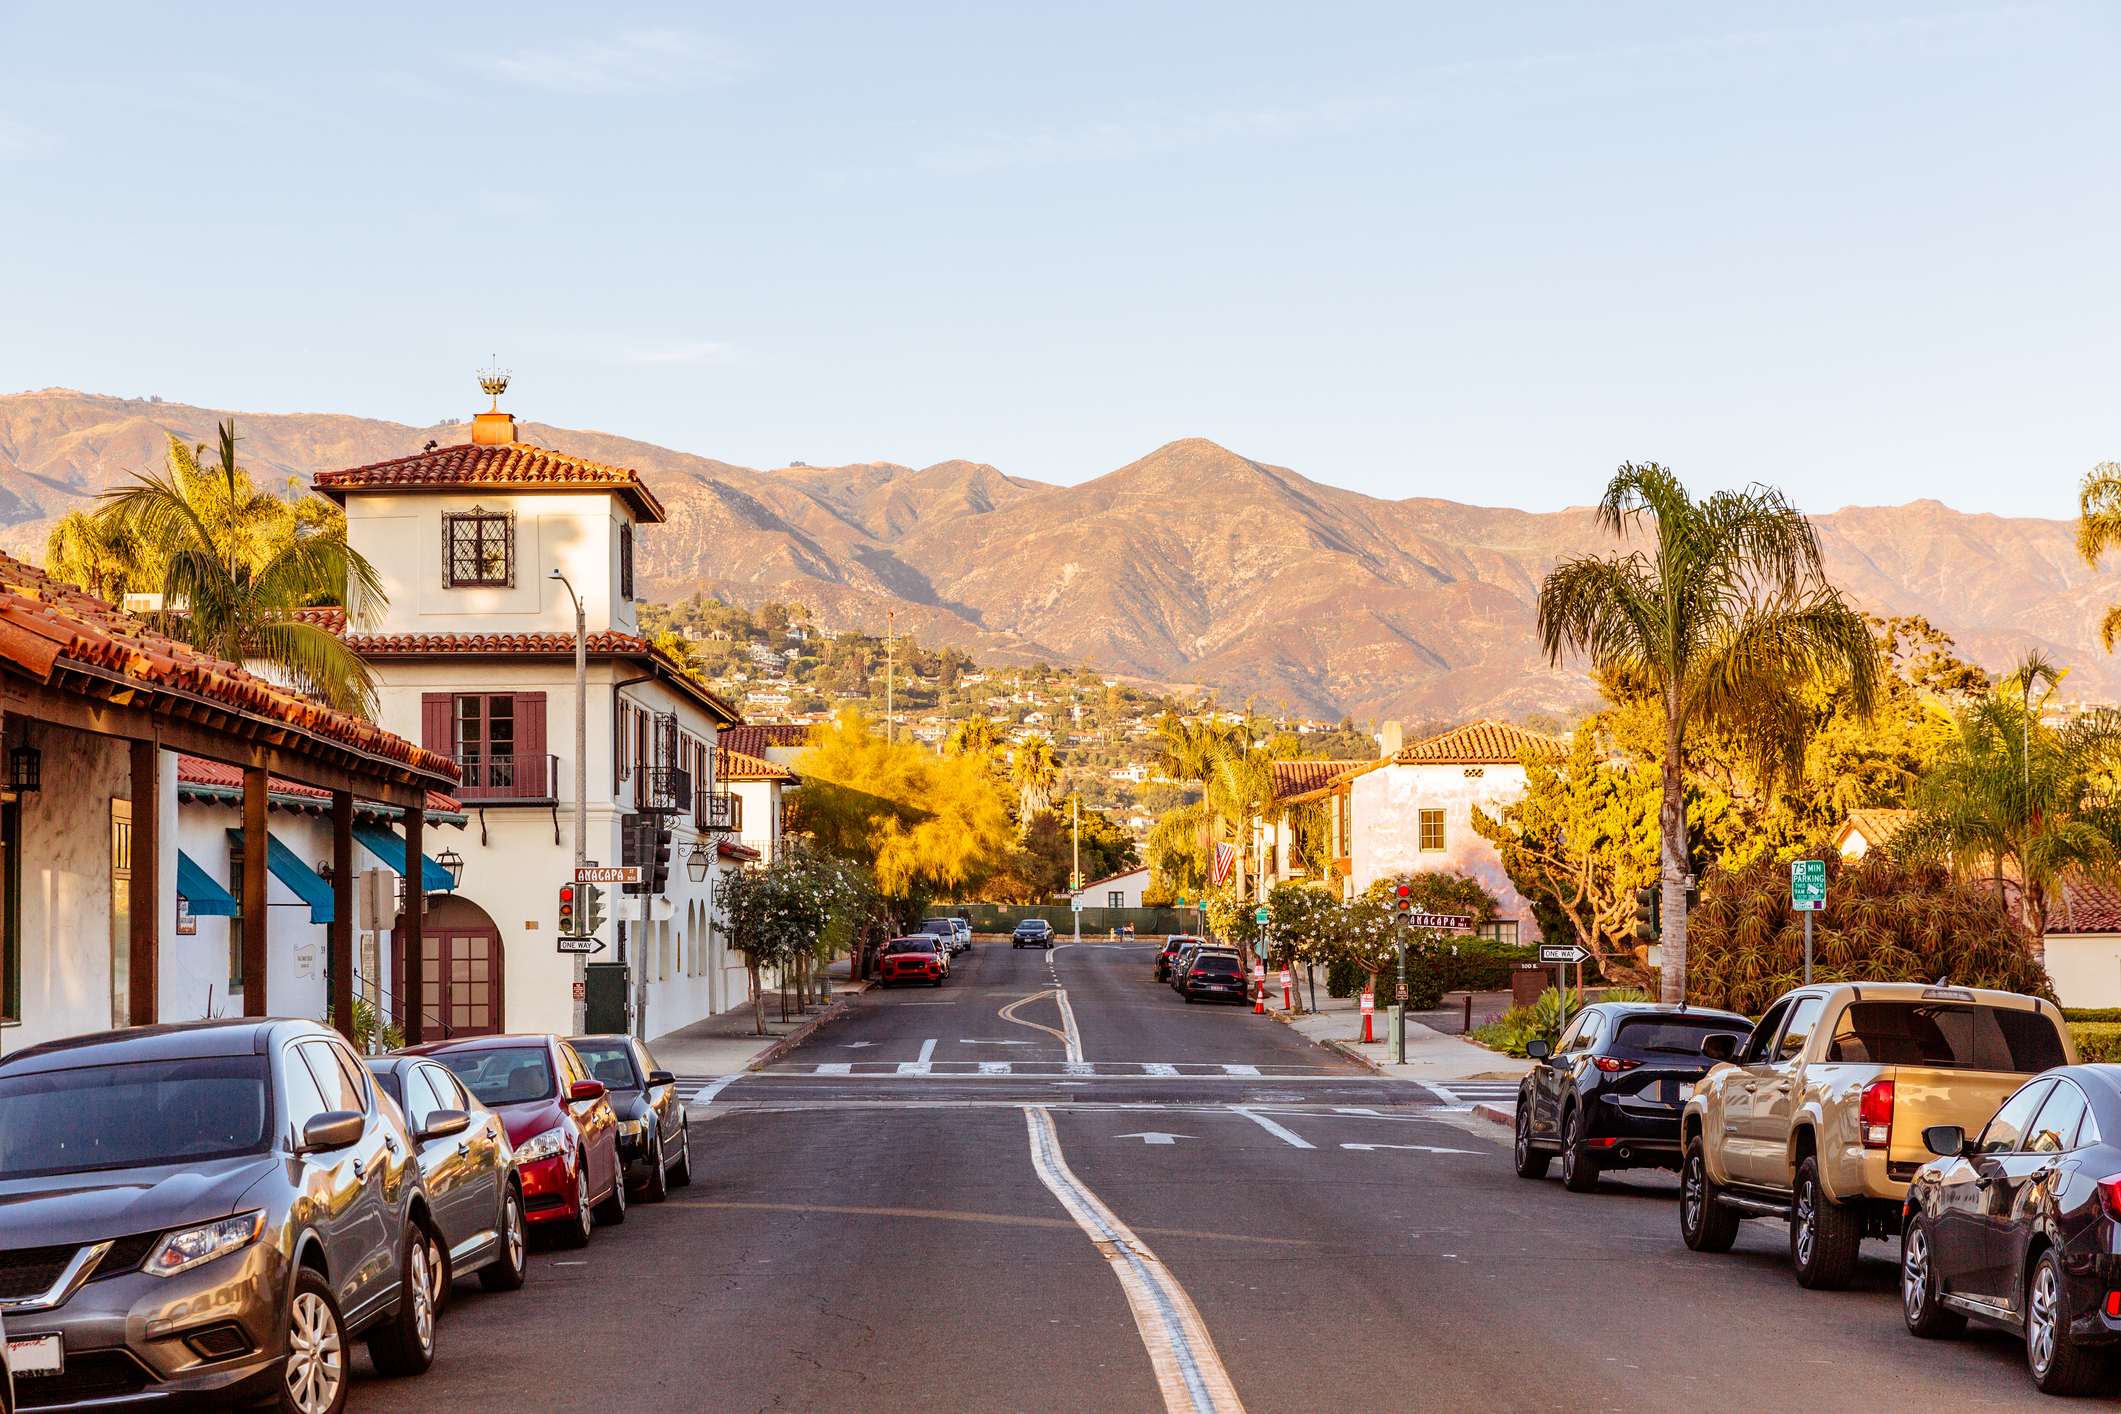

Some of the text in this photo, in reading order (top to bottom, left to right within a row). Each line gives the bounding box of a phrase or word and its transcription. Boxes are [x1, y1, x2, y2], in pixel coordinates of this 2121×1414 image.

[1793, 863, 1821, 874] 75 MIN
[578, 869, 624, 881] ANACAPA
[1794, 874, 1824, 882] PARKING
[1410, 916, 1455, 926] ANACAPA
